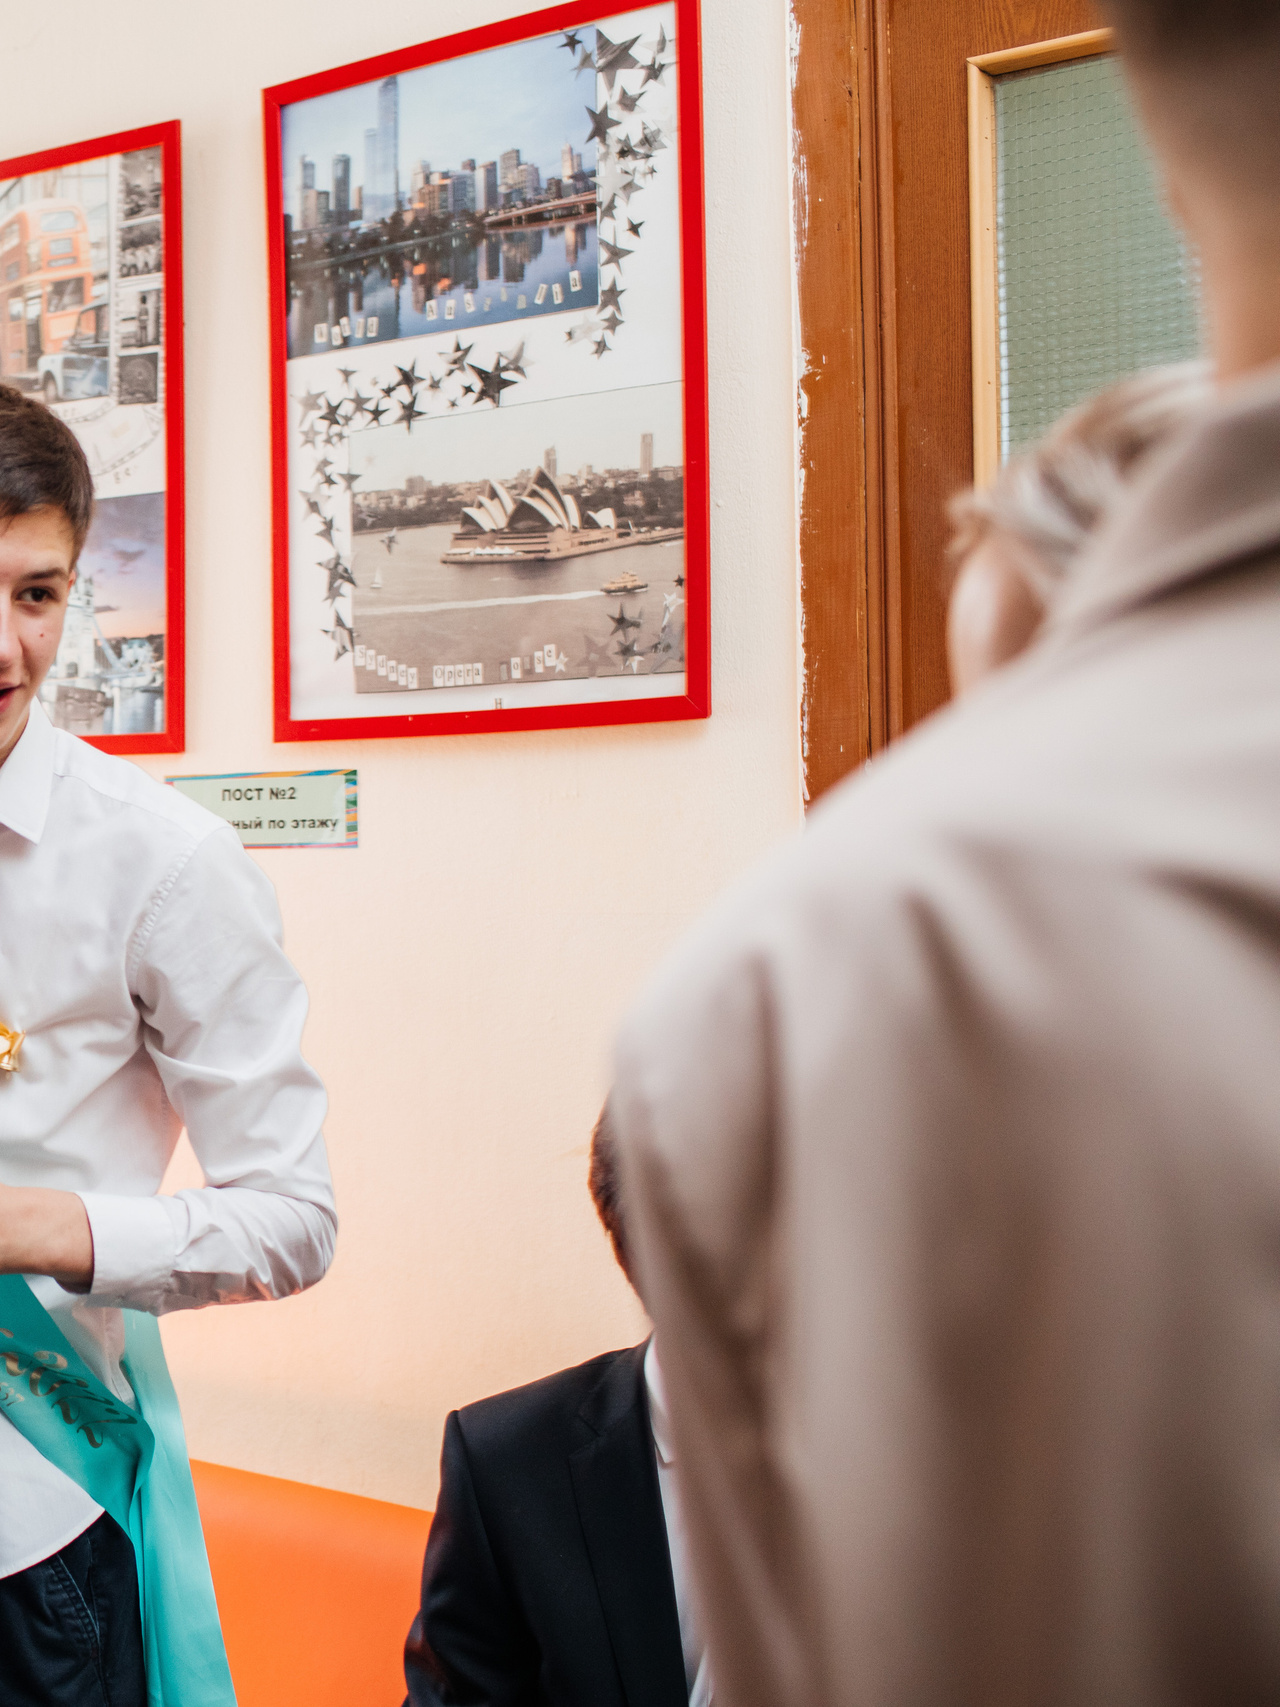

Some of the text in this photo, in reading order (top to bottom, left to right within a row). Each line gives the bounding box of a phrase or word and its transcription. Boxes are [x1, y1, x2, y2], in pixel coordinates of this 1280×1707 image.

[356, 646, 417, 684] Sydney
[434, 666, 481, 682] Opera
[221, 786, 297, 801] ПОСТ №2
[229, 816, 339, 831] ный по этажу
